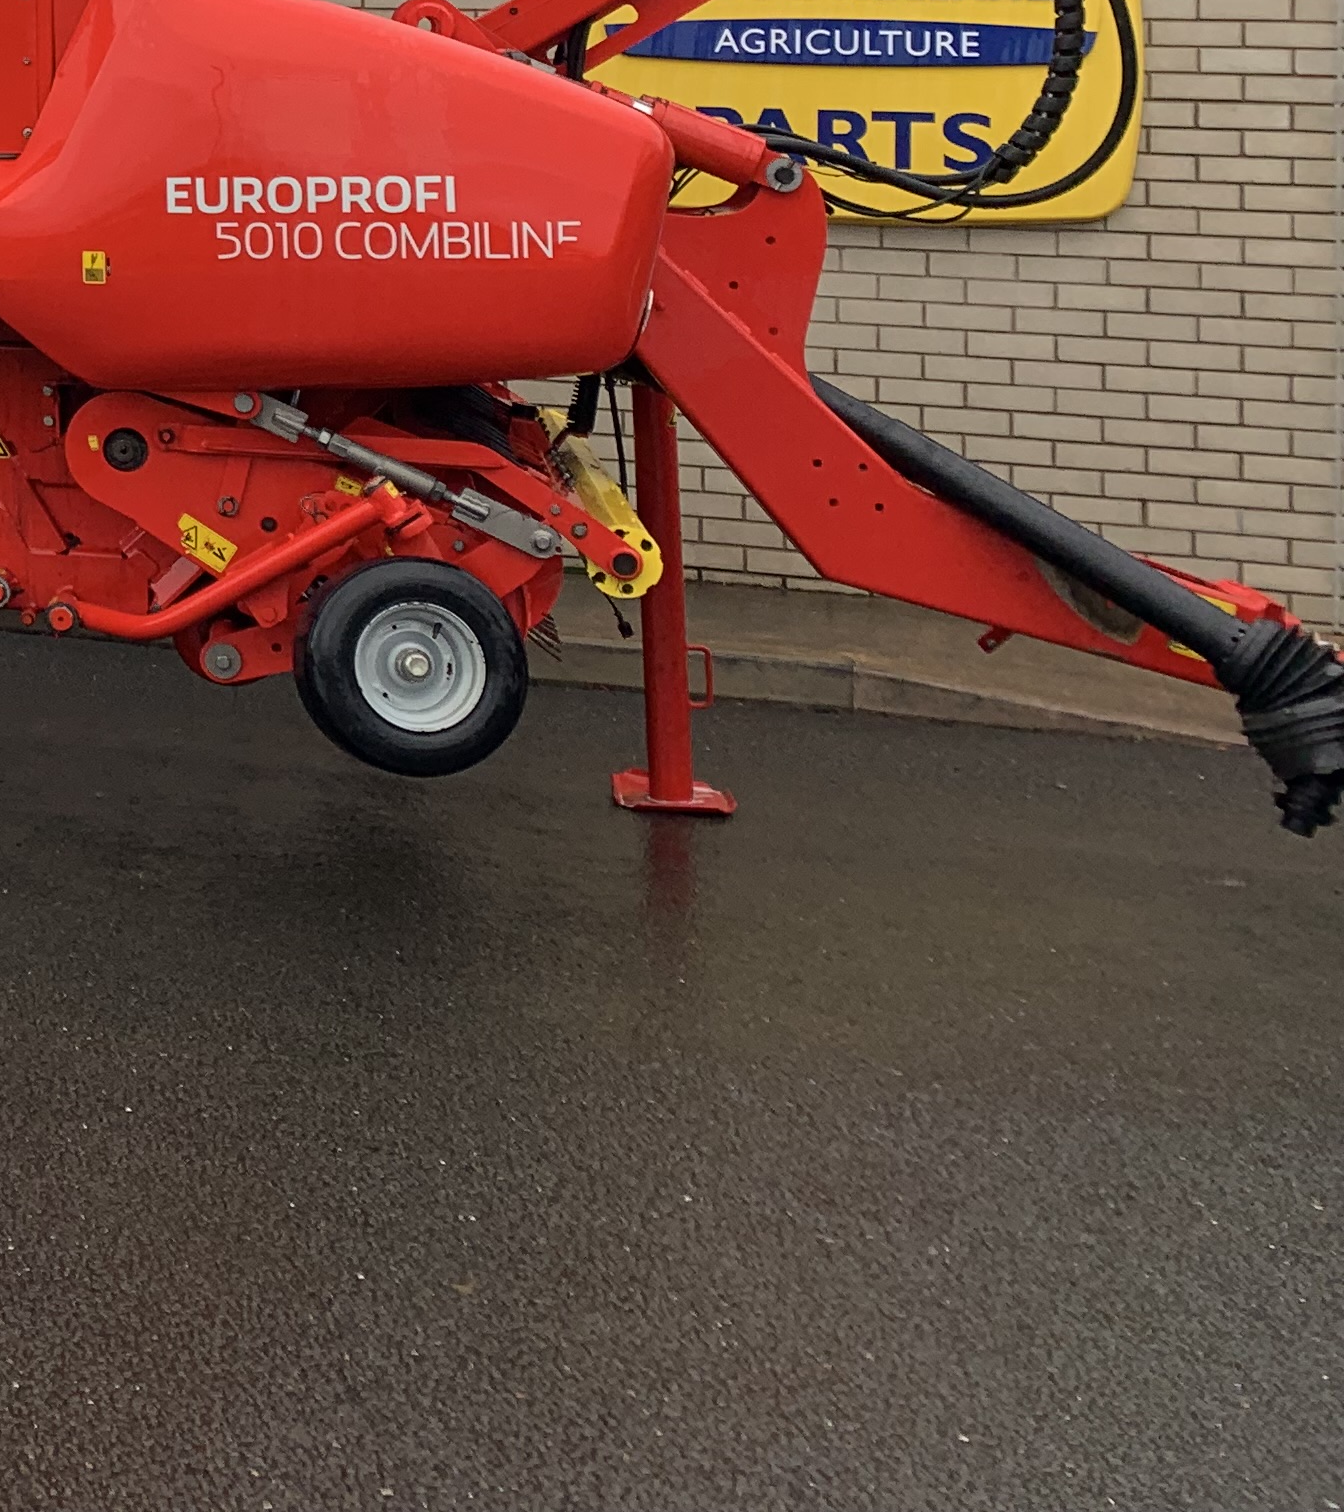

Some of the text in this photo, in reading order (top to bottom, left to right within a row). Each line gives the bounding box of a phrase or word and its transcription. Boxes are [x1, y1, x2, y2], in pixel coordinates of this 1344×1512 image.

[714, 28, 980, 58] AGRICULTURE
[166, 175, 457, 214] EUROPROFI
[216, 221, 323, 260] 5010
